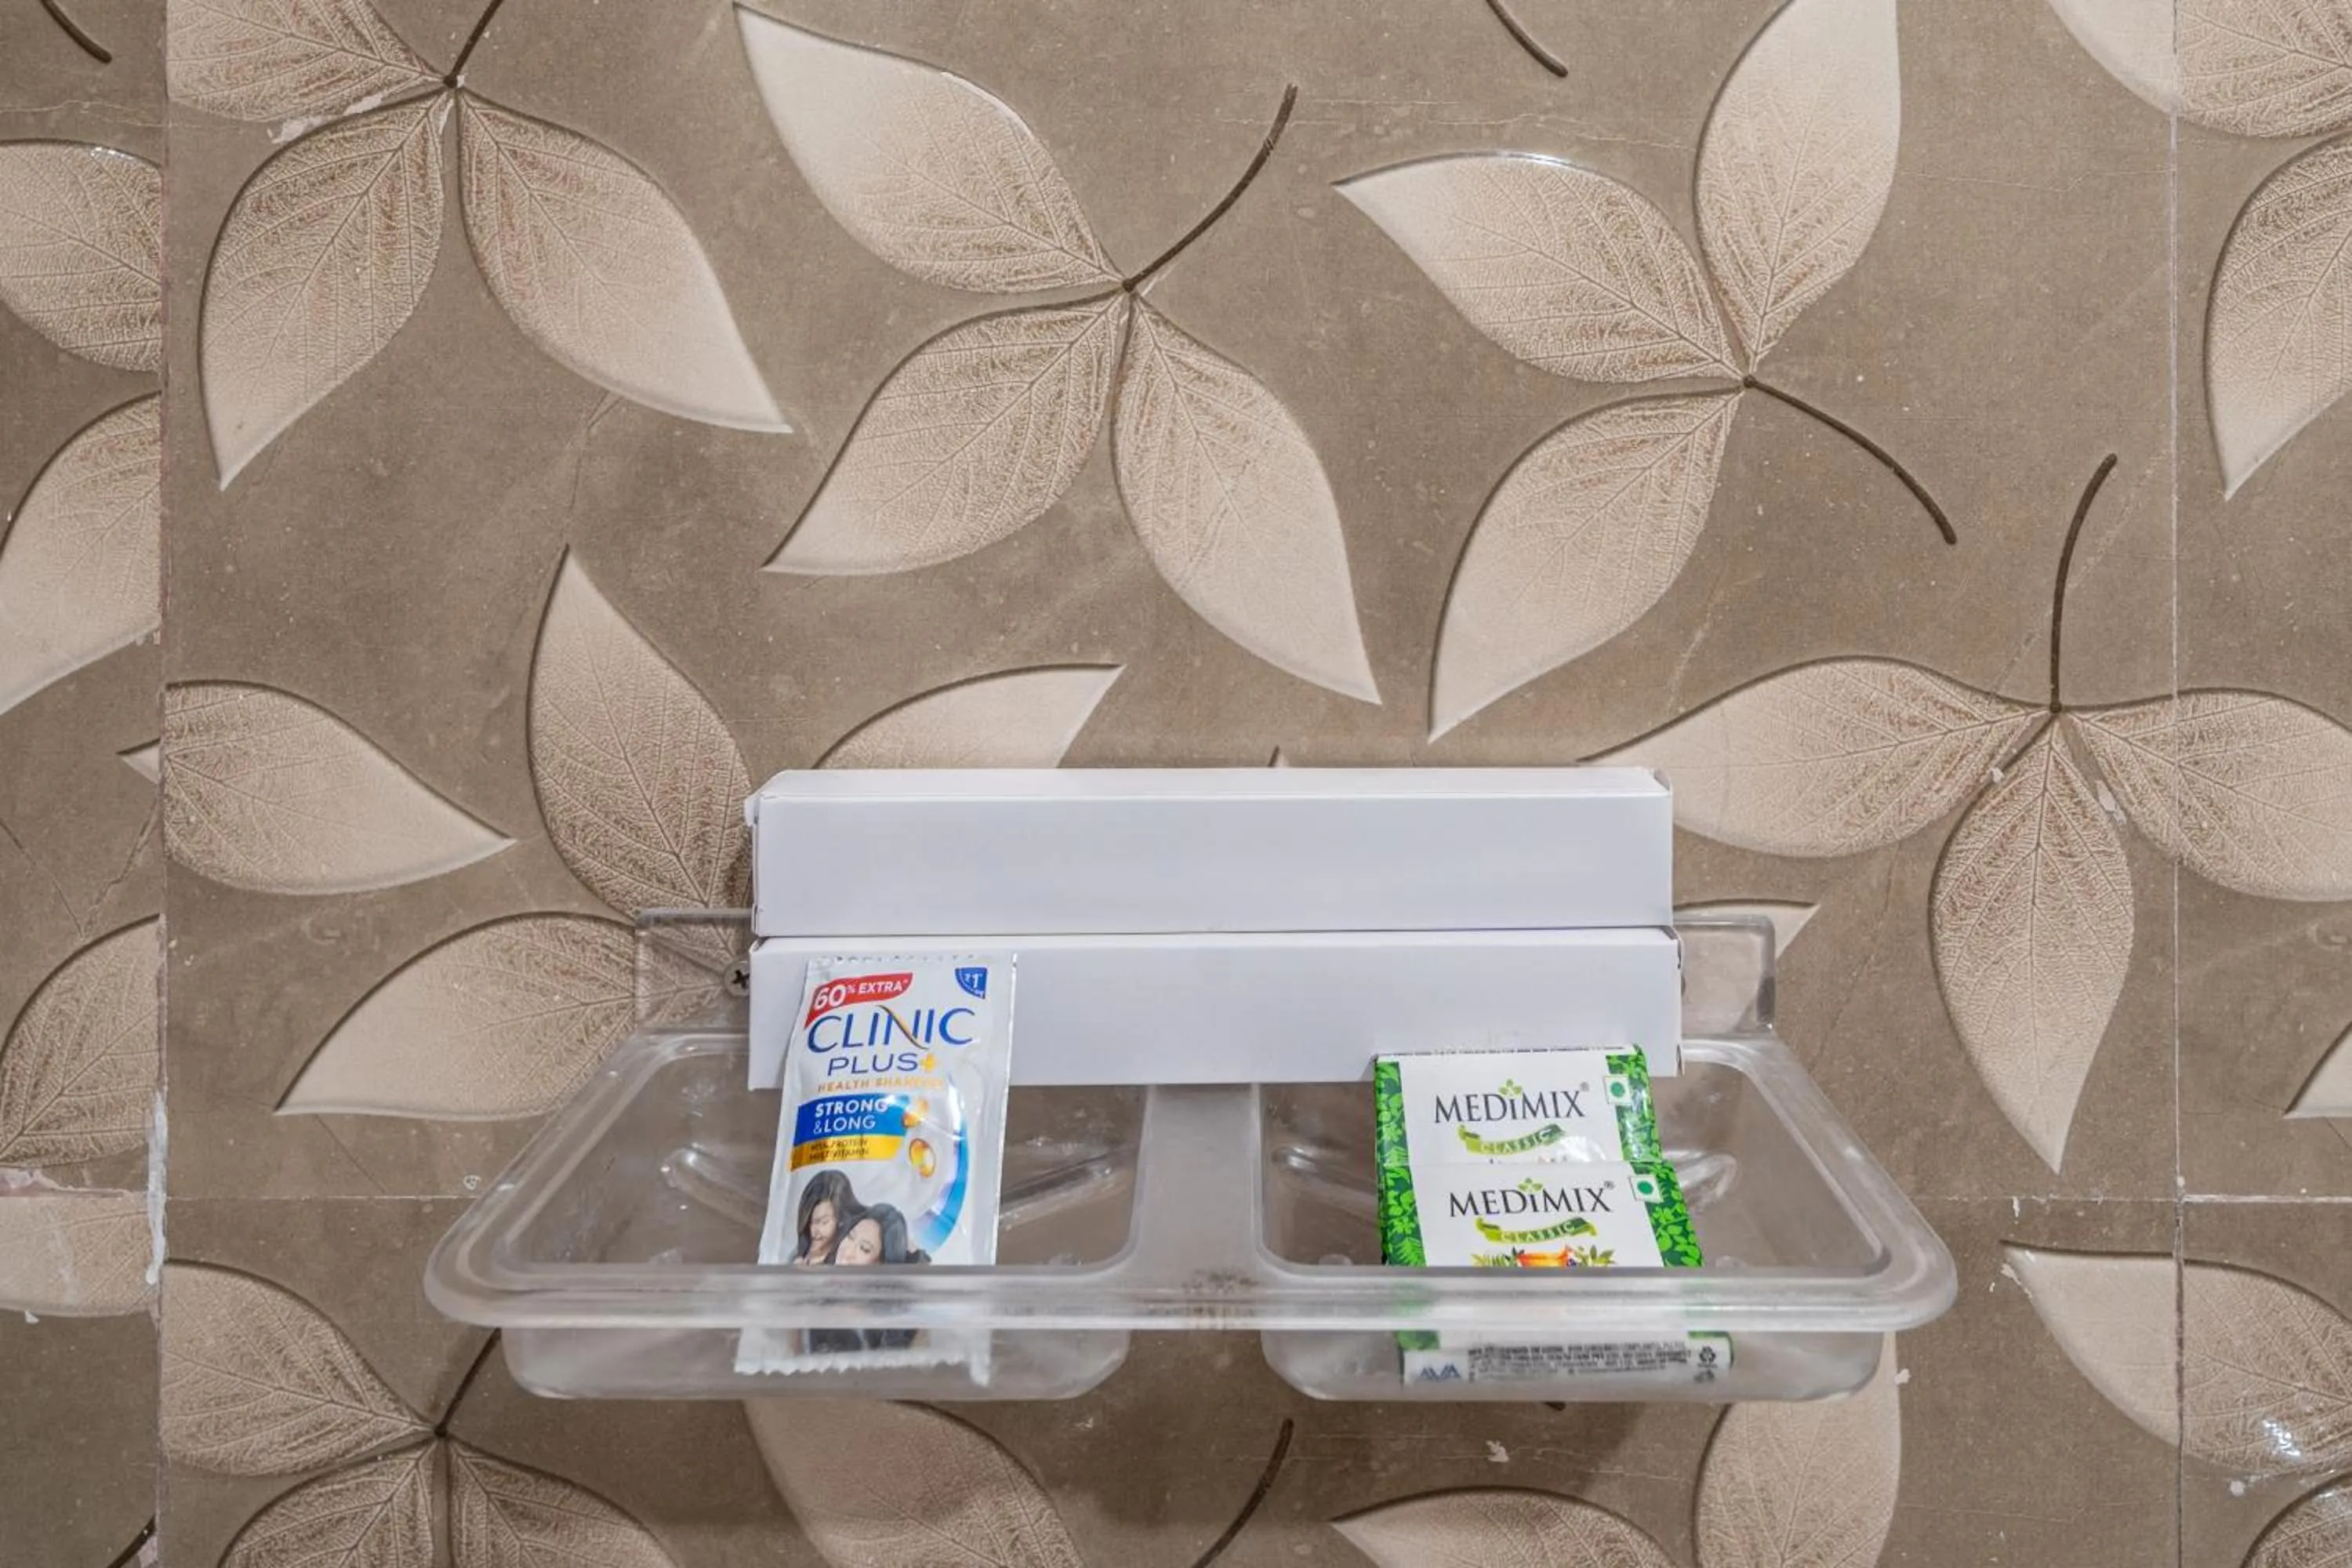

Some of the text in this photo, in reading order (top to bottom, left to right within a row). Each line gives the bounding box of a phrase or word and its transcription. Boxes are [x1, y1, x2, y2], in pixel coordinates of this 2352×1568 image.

[814, 984, 855, 1010] 60%
[807, 1005, 975, 1054] CLINIC
[818, 1076, 943, 1093] HEALTH SHAMP
[815, 1098, 889, 1118] STRONG
[1479, 1127, 1553, 1155] CLASSIC
[1501, 1221, 1576, 1243] CLASSIC
